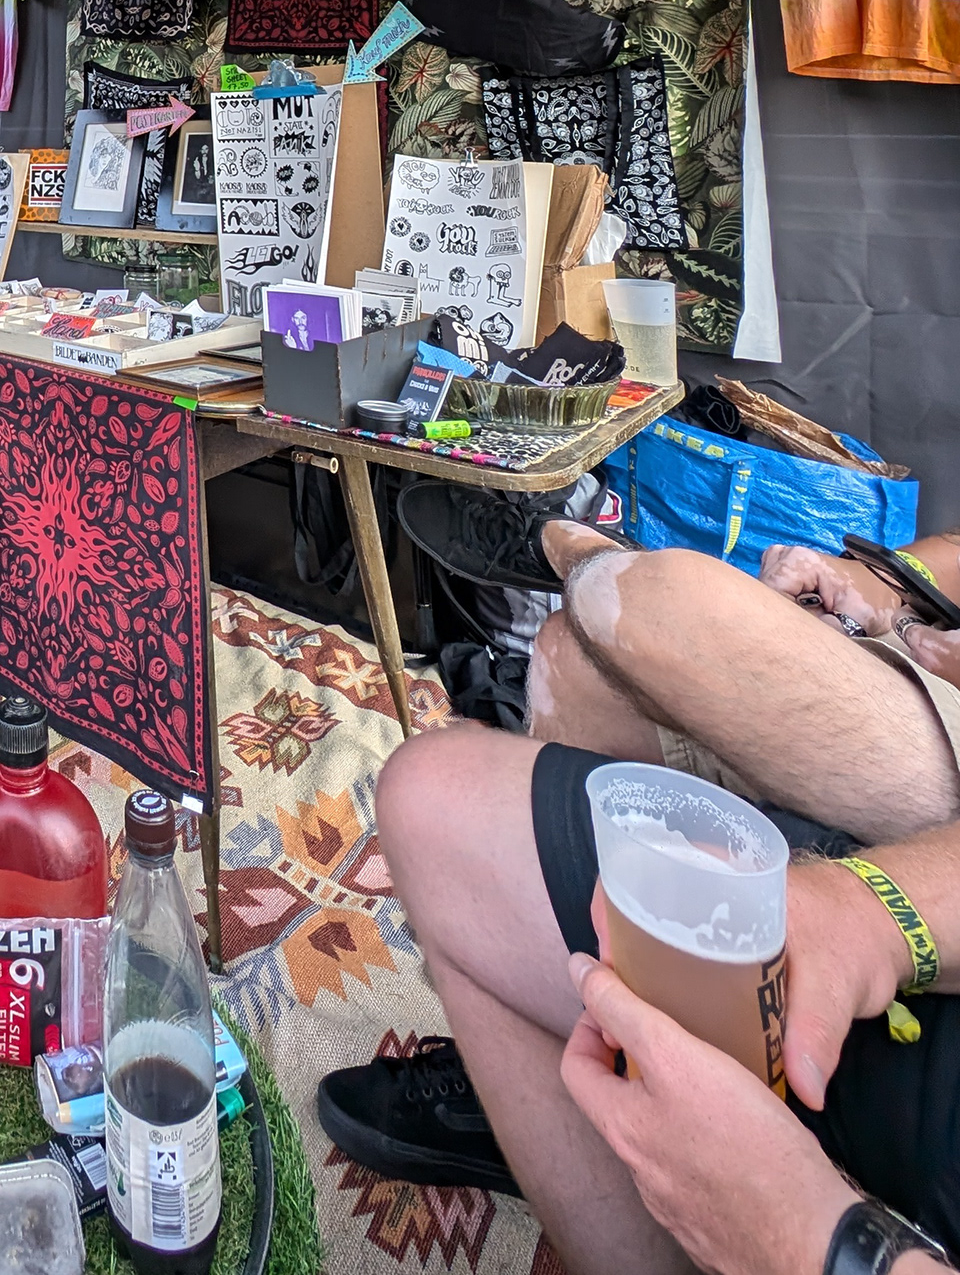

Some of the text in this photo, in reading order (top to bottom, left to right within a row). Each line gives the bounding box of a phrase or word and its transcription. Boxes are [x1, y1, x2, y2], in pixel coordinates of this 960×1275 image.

[272, 95, 315, 120] MUT
[31, 170, 66, 184] FCK
[31, 184, 65, 197] NZS
[654, 423, 724, 459] IKEA
[865, 874, 924, 933] WALD
[9, 958, 45, 990] 6
